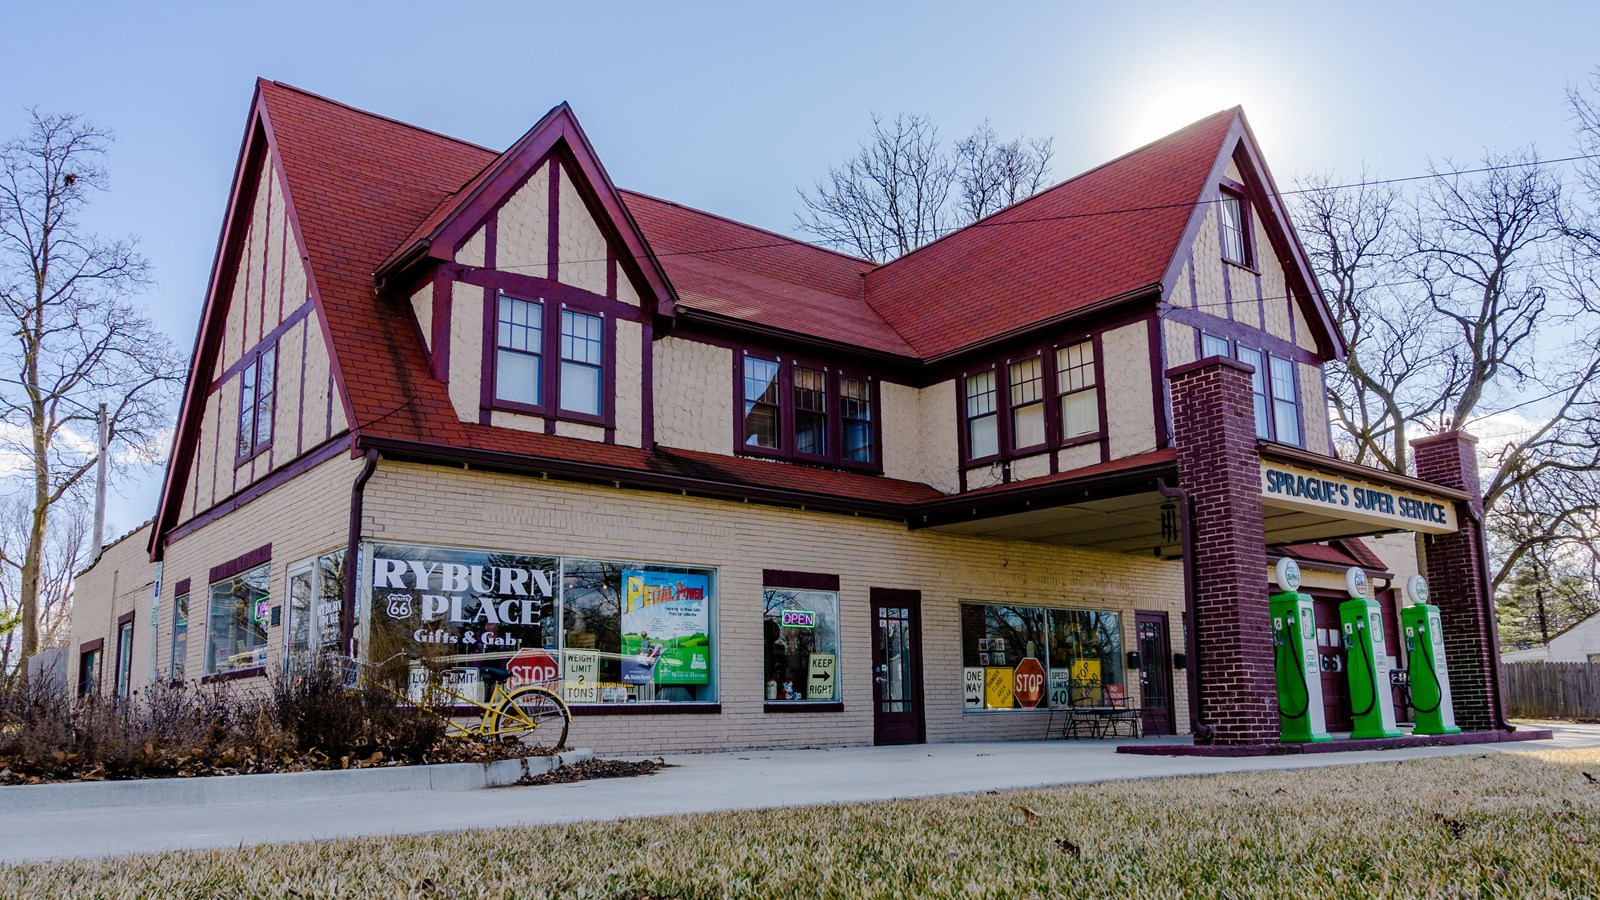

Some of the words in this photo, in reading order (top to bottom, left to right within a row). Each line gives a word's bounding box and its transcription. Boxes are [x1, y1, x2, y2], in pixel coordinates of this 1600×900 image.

[1266, 469, 1349, 506] SPRAGUE'S
[1353, 486, 1395, 515] SUPER
[1399, 496, 1446, 525] SERVICE
[373, 558, 554, 597] RYBURN
[626, 576, 674, 613] PEDAL
[390, 601, 409, 615] 66
[421, 594, 541, 626] PLACE
[784, 613, 813, 625] OPEN
[414, 628, 458, 644] Gifts
[462, 630, 477, 644] &
[481, 631, 517, 646] Gab
[567, 654, 597, 663] WEIGHT
[812, 658, 833, 668] KEEP
[571, 664, 592, 673] LIMIT
[511, 666, 556, 687] STOP
[578, 674, 585, 686] 2
[966, 670, 982, 681] ONE
[986, 669, 1000, 688] DANGER
[1051, 671, 1068, 680] SPEED
[966, 683, 982, 693] WAY
[992, 677, 1003, 692] FLOOD
[1016, 673, 1044, 693] STOP
[1053, 681, 1068, 689] LIMIT
[568, 687, 594, 699] TONS
[809, 685, 833, 695] RIGHT
[997, 685, 1007, 698] AREA
[1051, 690, 1067, 705] 40
